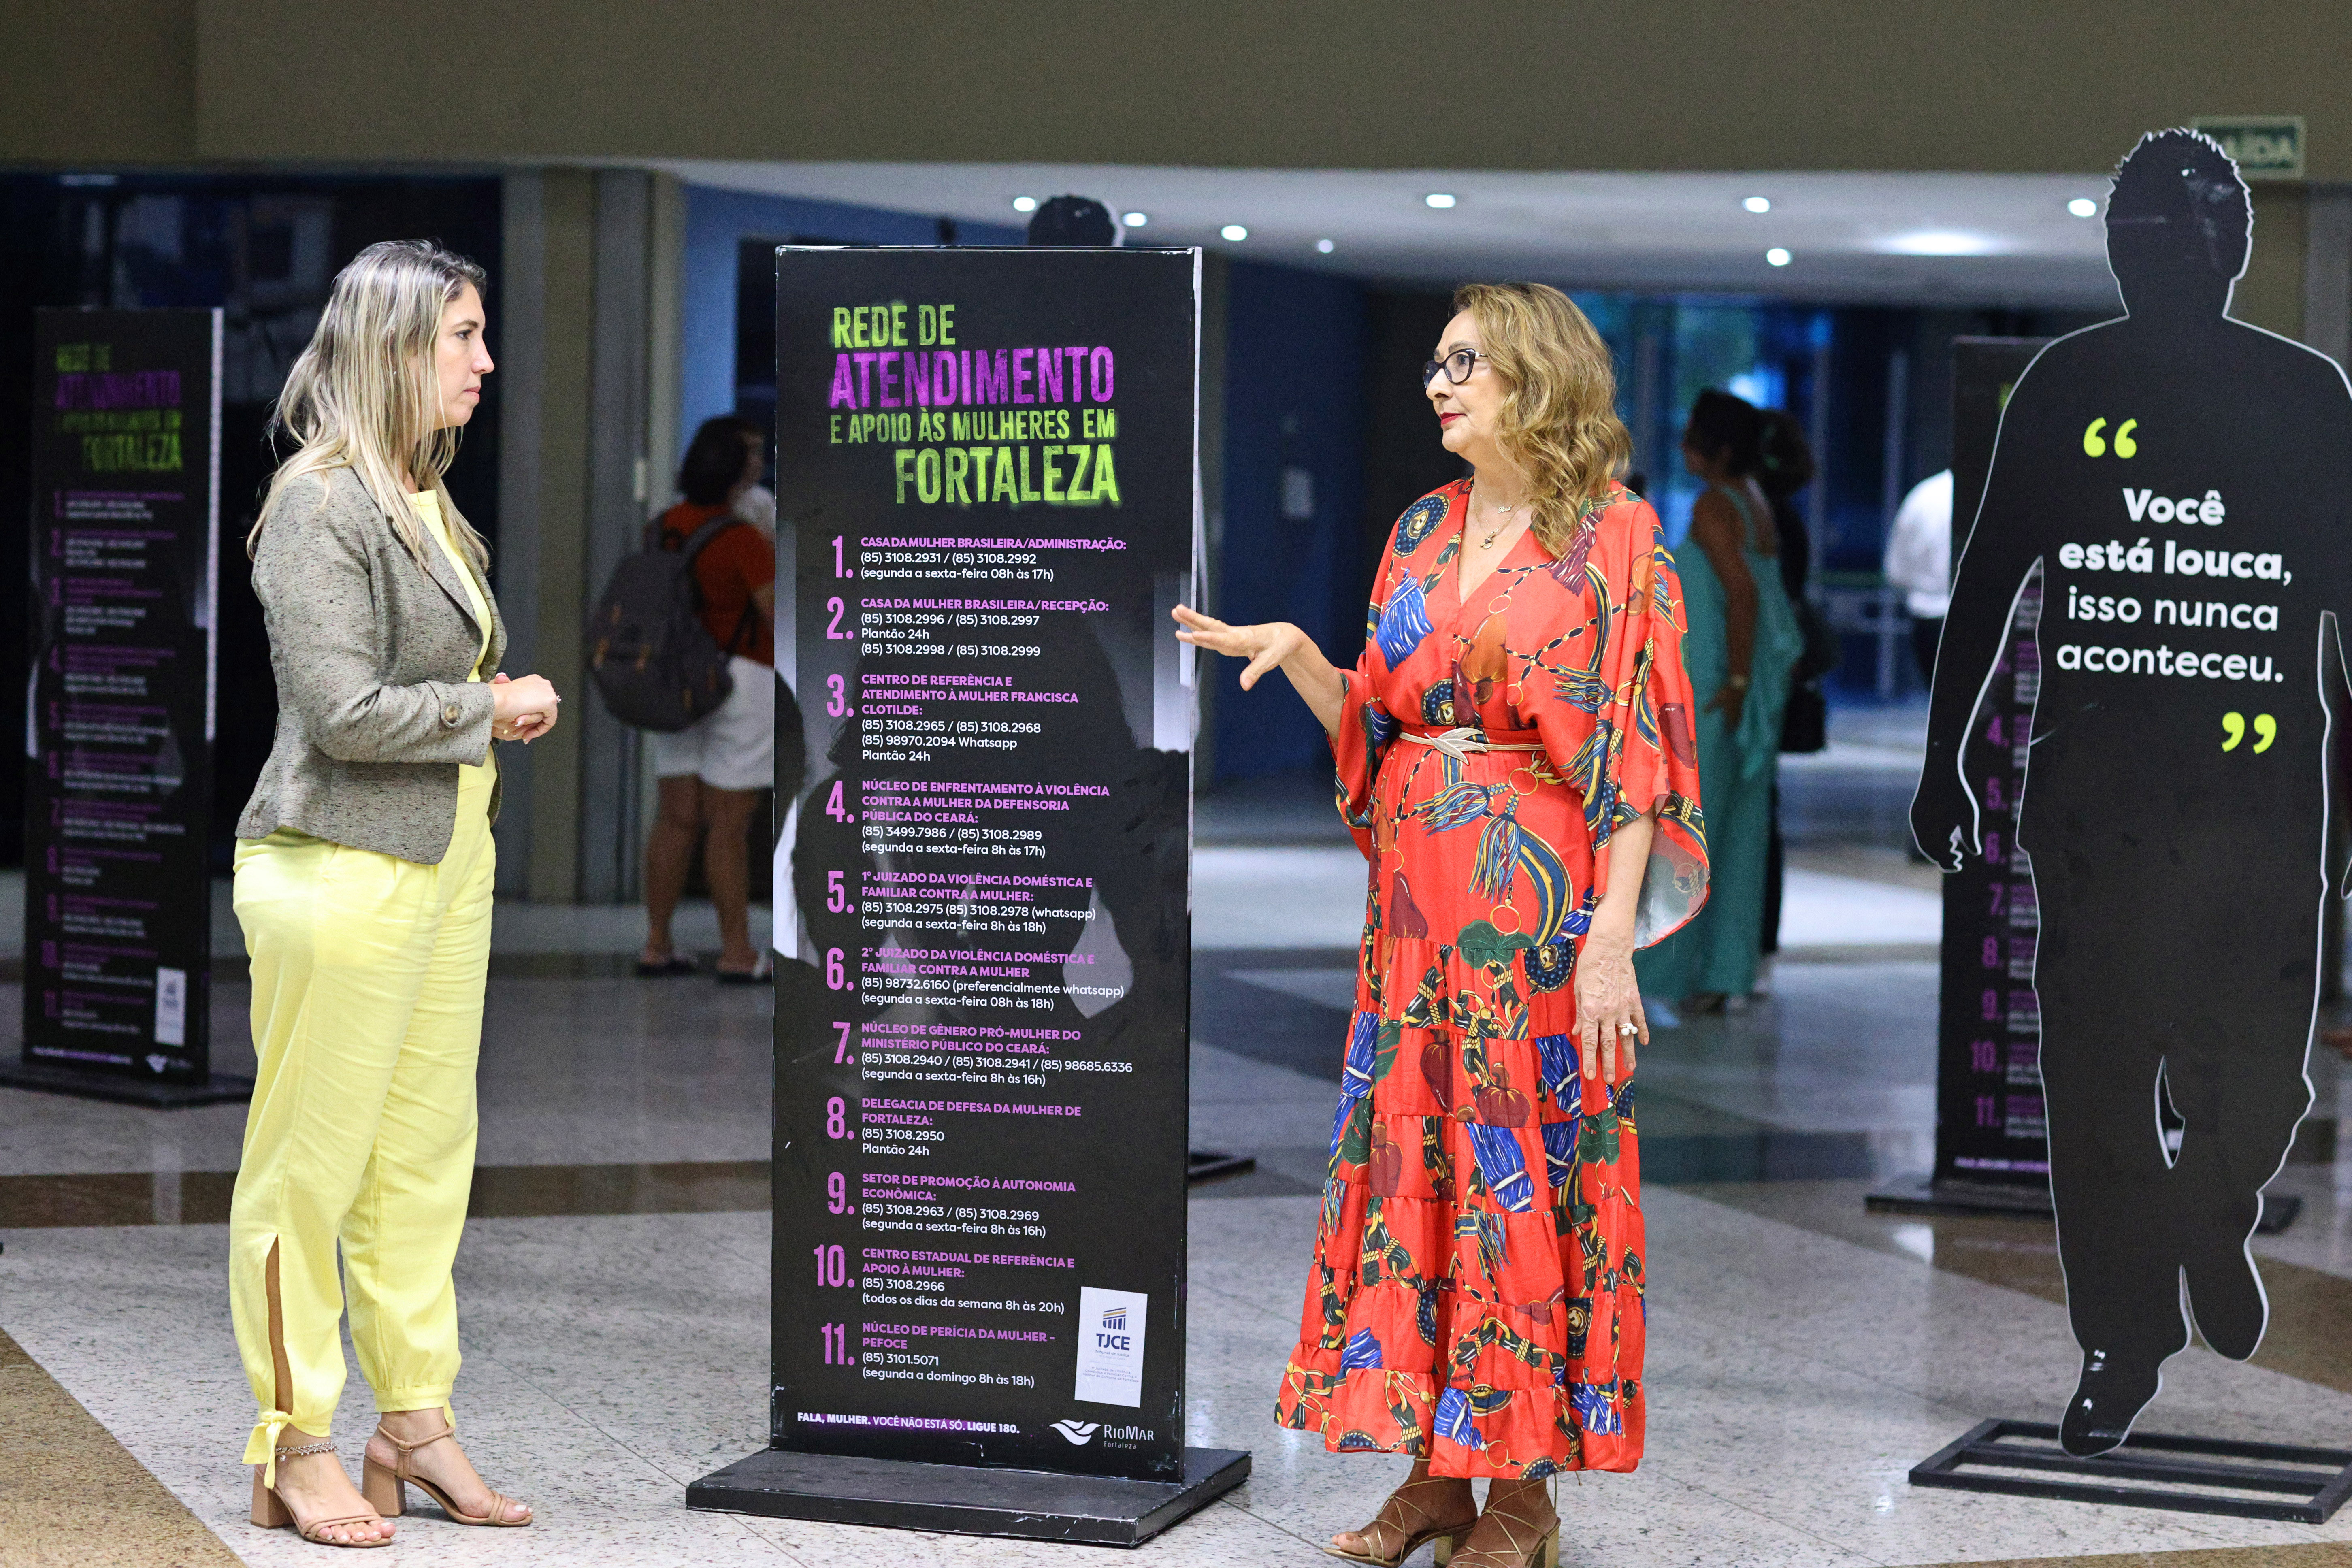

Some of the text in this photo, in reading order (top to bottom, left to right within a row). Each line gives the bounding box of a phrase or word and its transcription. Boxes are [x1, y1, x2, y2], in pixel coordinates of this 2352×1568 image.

[833, 304, 956, 349] REDE DE
[830, 346, 1114, 410] ATENDIMENTO
[831, 407, 1115, 444] E APOIO ÀS MULHERES EM
[895, 444, 1120, 504] FORTALEZA
[2122, 488, 2226, 526] Você
[861, 537, 1127, 552] CASA DA MULHER BRASILEIRA/ADMINISTRAÇÃO:
[832, 535, 853, 578] 1.
[861, 552, 1036, 566] (85) 3108.2931 / (85) 3108.2992
[2058, 537, 2292, 586] está louca,
[861, 567, 1054, 582] (segunda a sexta-feira 08h às 17h)
[827, 597, 854, 639] 2.
[2068, 585, 2142, 623] isso
[2154, 599, 2278, 631] nunca
[2056, 644, 2284, 683] aconteceu.
[861, 673, 1012, 686] CENTRO DE REFERÊNCIA E
[827, 674, 854, 717] 3.
[862, 688, 1079, 703] ATENDIMENTO À MULHER FRANCISCA
[861, 705, 922, 715] CLOTILDE:
[862, 719, 1041, 735] (85) 3108.2965 / (85) 3108.2968
[862, 734, 1017, 751] (85) 98970.2094 Whatsapp
[862, 749, 930, 761] Plantão 24h
[826, 780, 854, 823] 4.
[827, 871, 854, 913] 5.
[875, 948, 929, 959] JUIZADO
[931, 950, 948, 960] DA
[949, 948, 1012, 962] VIOLÊNCIA
[1014, 950, 1086, 966] DOMÉSTICA
[1087, 954, 1095, 965] E
[827, 947, 854, 991] 6.
[862, 962, 1030, 978] FAMILIAR CONTRA A MULHER
[861, 976, 1124, 999] (85) 98732.6160 (preferencialmente whatsapp)
[861, 992, 912, 1006] (segunda
[925, 995, 987, 1006] sexta-feira
[990, 997, 1013, 1008] 08h
[1016, 997, 1029, 1008] às
[1031, 998, 1054, 1011] 18h)
[833, 1022, 854, 1065] 7.
[862, 1098, 1081, 1116] DELEGACIA DE DEFESA DA MULHER DE
[827, 1096, 854, 1139] 8.
[862, 1113, 933, 1125] FORTALEZA:
[862, 1127, 945, 1141] (85) 3108.2950
[863, 1143, 929, 1156] Plantão 24h
[828, 1171, 855, 1215] 9.
[814, 1244, 855, 1288] 10.
[862, 1248, 1074, 1268] CENTRO ESTADUAL DE REFERÊNCIA E
[862, 1263, 965, 1278] APOIO À MULHER:
[862, 1277, 945, 1291] (85) 3108.2966
[862, 1292, 1064, 1315] (todos os dias da semana 8h às 20h)
[821, 1322, 855, 1366] 11.
[863, 1337, 908, 1349] PEFOCE
[1096, 1333, 1130, 1351] TJCE
[862, 1351, 939, 1366] (85) 3101.5071
[797, 1412, 1020, 1434] FALA, MULHER. VOCÊ NÃO ESTÁ SÓ. LIGUE 180.
[1104, 1440, 1137, 1449] Fortaleza
